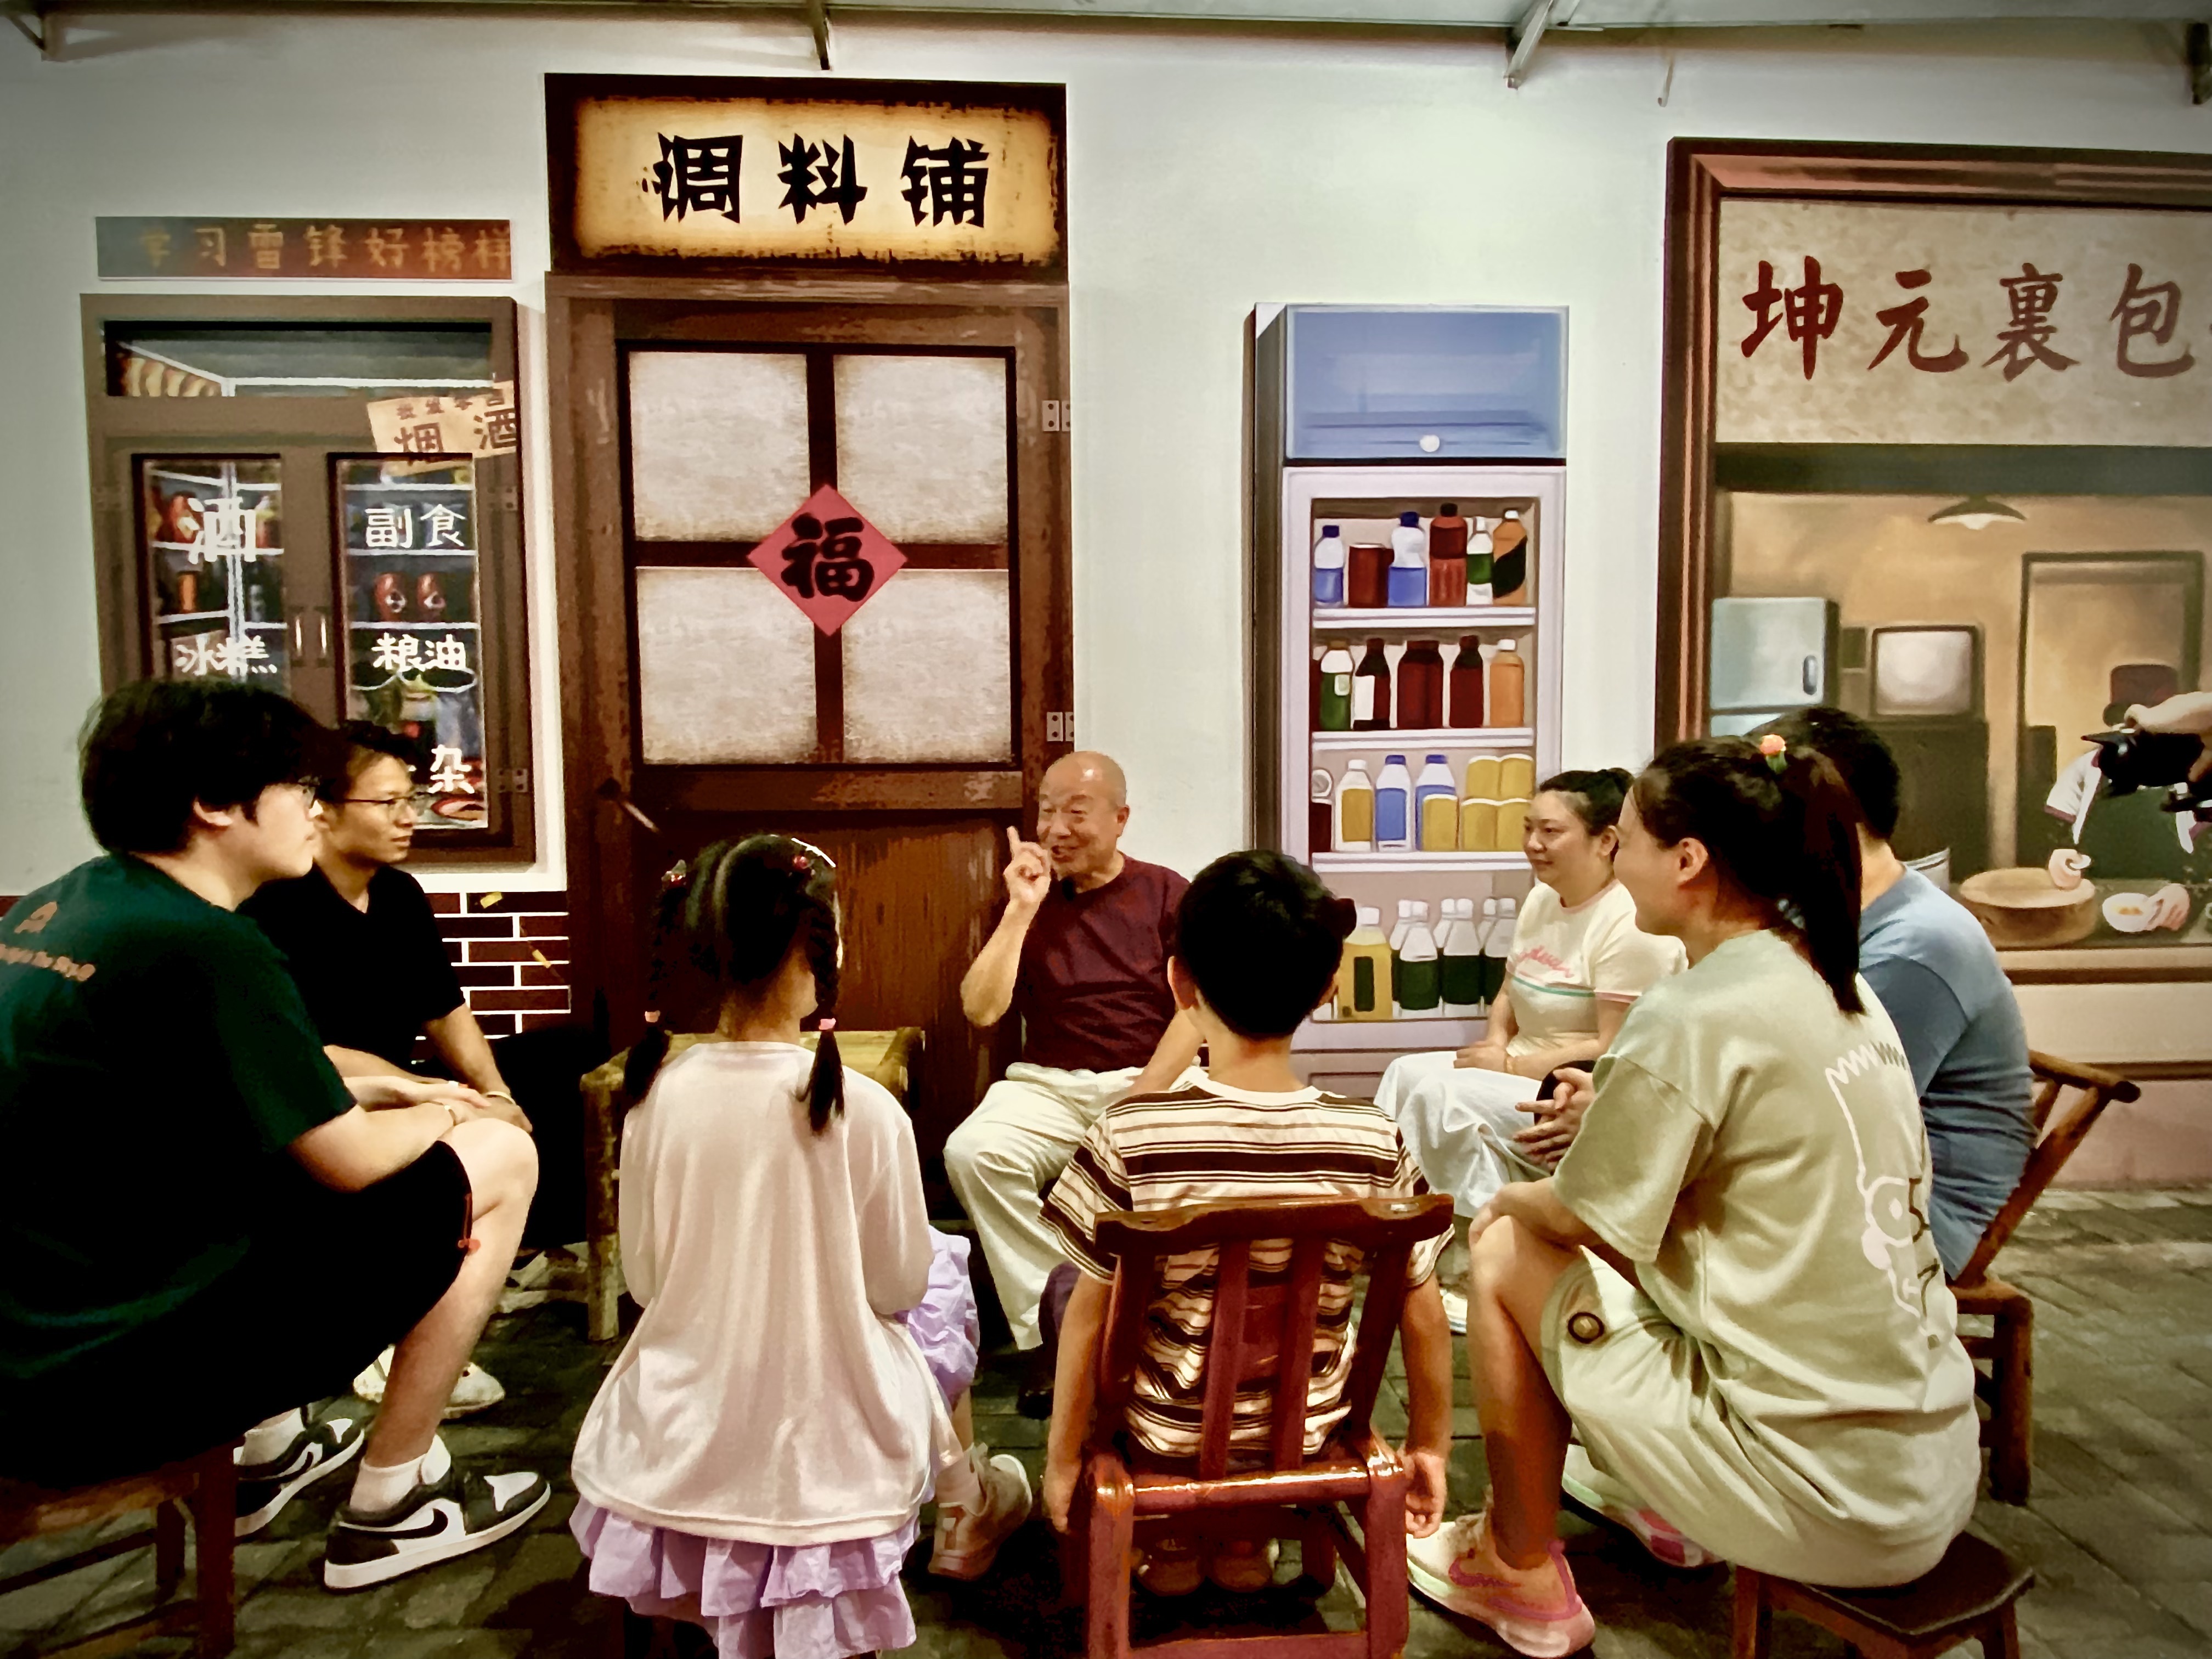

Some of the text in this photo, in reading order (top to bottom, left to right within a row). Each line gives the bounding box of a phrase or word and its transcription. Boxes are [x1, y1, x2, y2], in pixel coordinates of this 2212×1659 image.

[652, 132, 989, 228] 调料铺
[1741, 256, 2212, 382] 坤元裏包
[364, 504, 466, 549] 副食
[781, 512, 875, 602] 福
[371, 632, 466, 672] 粮油
[408, 744, 475, 794] 杂
